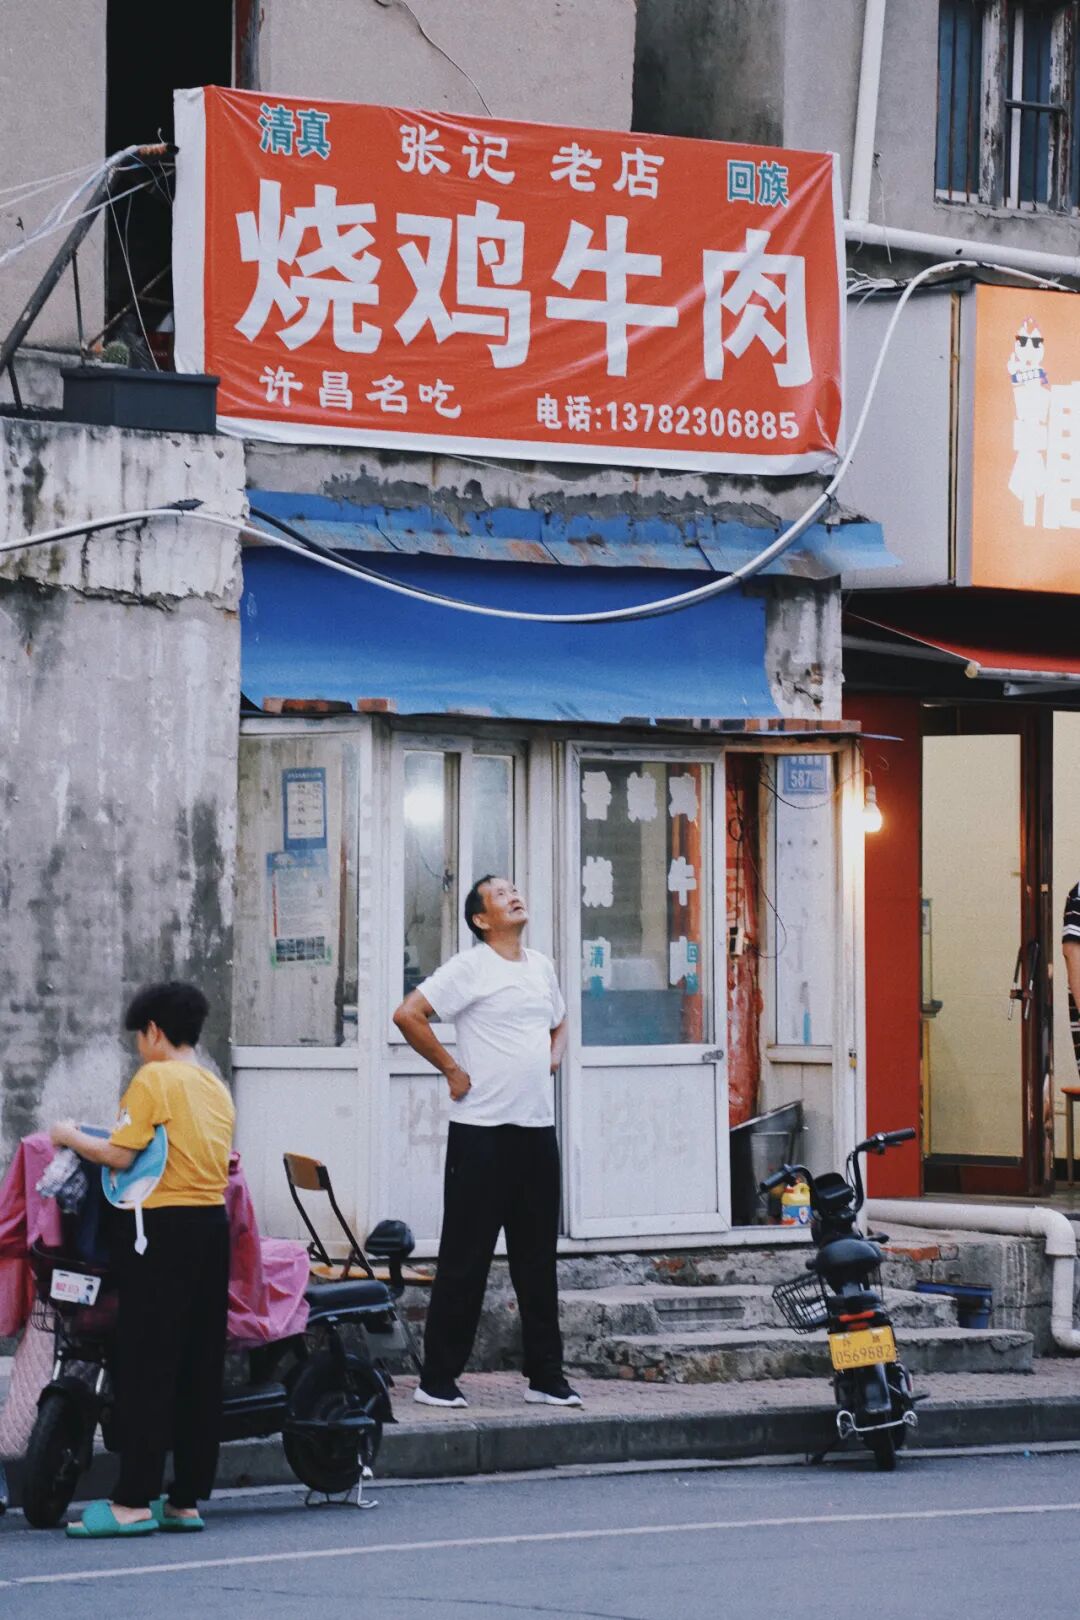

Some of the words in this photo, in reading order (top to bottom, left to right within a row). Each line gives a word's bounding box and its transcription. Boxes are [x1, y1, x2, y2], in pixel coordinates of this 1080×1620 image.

[258, 103, 332, 160] 清真
[397, 124, 515, 186] 张记
[551, 142, 665, 199] 老店
[726, 159, 791, 209] 回族
[234, 178, 815, 389] 烧鸡牛肉
[258, 365, 462, 420] 许昌名吃
